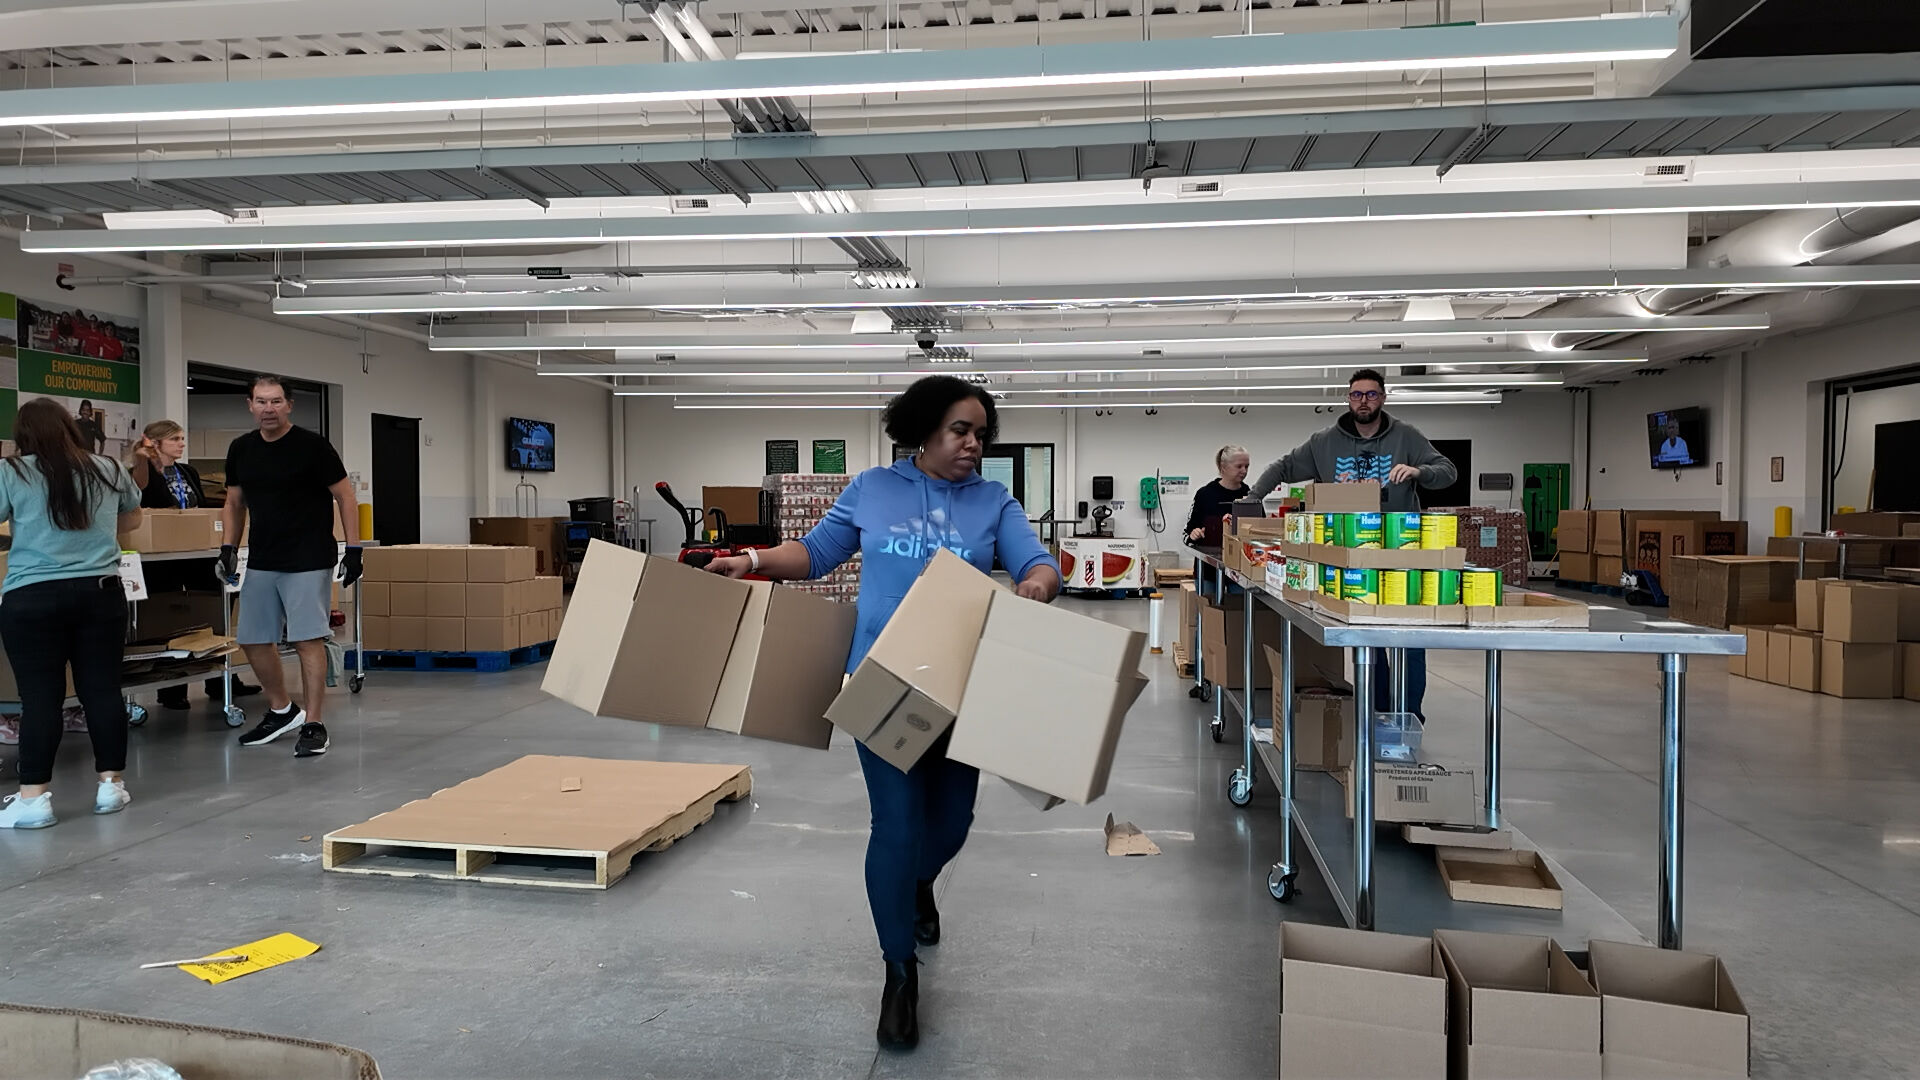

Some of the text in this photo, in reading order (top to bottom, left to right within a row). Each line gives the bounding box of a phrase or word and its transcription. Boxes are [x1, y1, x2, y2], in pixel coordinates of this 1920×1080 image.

[52, 360, 112, 379] EMPOWERING
[45, 374, 118, 394] OUR COMMUNITY
